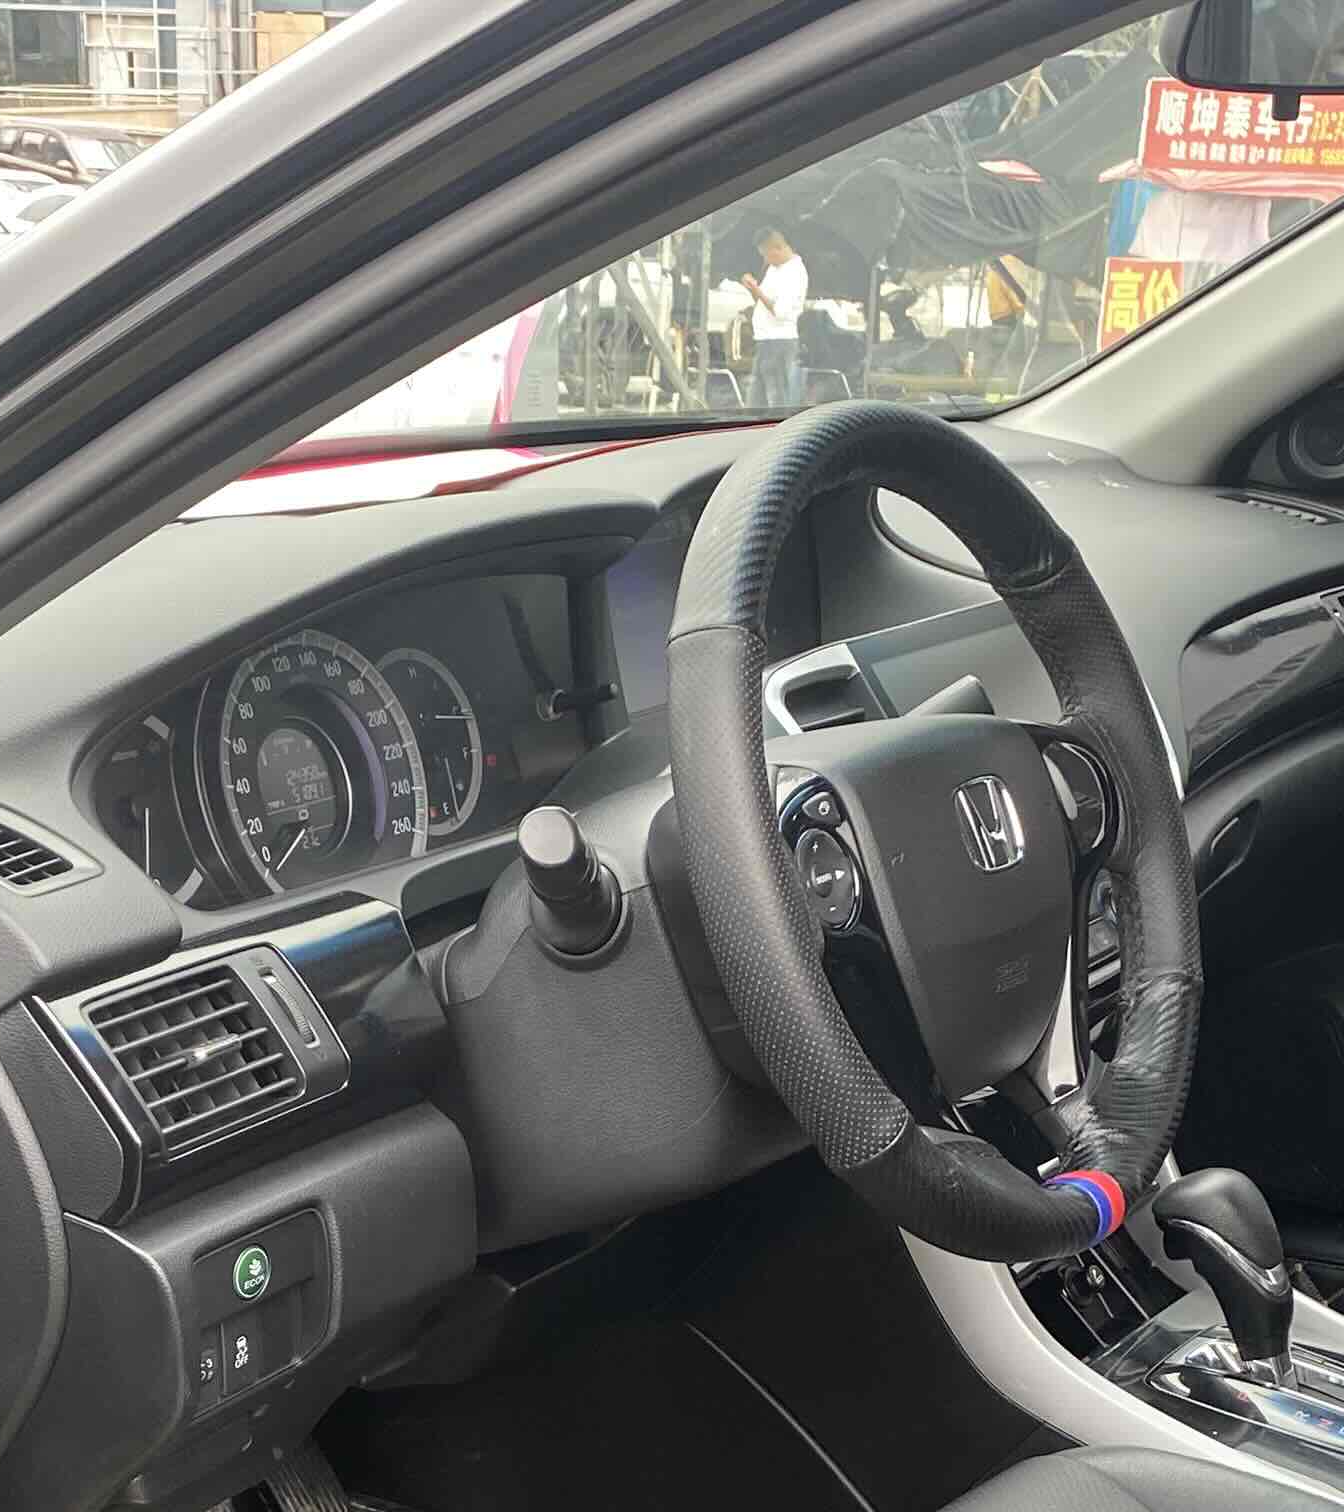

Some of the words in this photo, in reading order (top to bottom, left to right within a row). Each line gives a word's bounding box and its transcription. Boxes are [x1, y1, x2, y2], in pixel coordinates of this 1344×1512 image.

[272, 656, 291, 672] 120
[298, 651, 317, 667] 140
[323, 661, 342, 678] 160
[251, 675, 271, 692] 100
[238, 703, 254, 720] 80
[366, 709, 388, 727] 200
[232, 737, 247, 755] 60
[383, 743, 403, 761] 220
[236, 778, 250, 794] 40
[391, 778, 411, 797] 240
[247, 816, 263, 835] 20
[392, 816, 412, 835] 260
